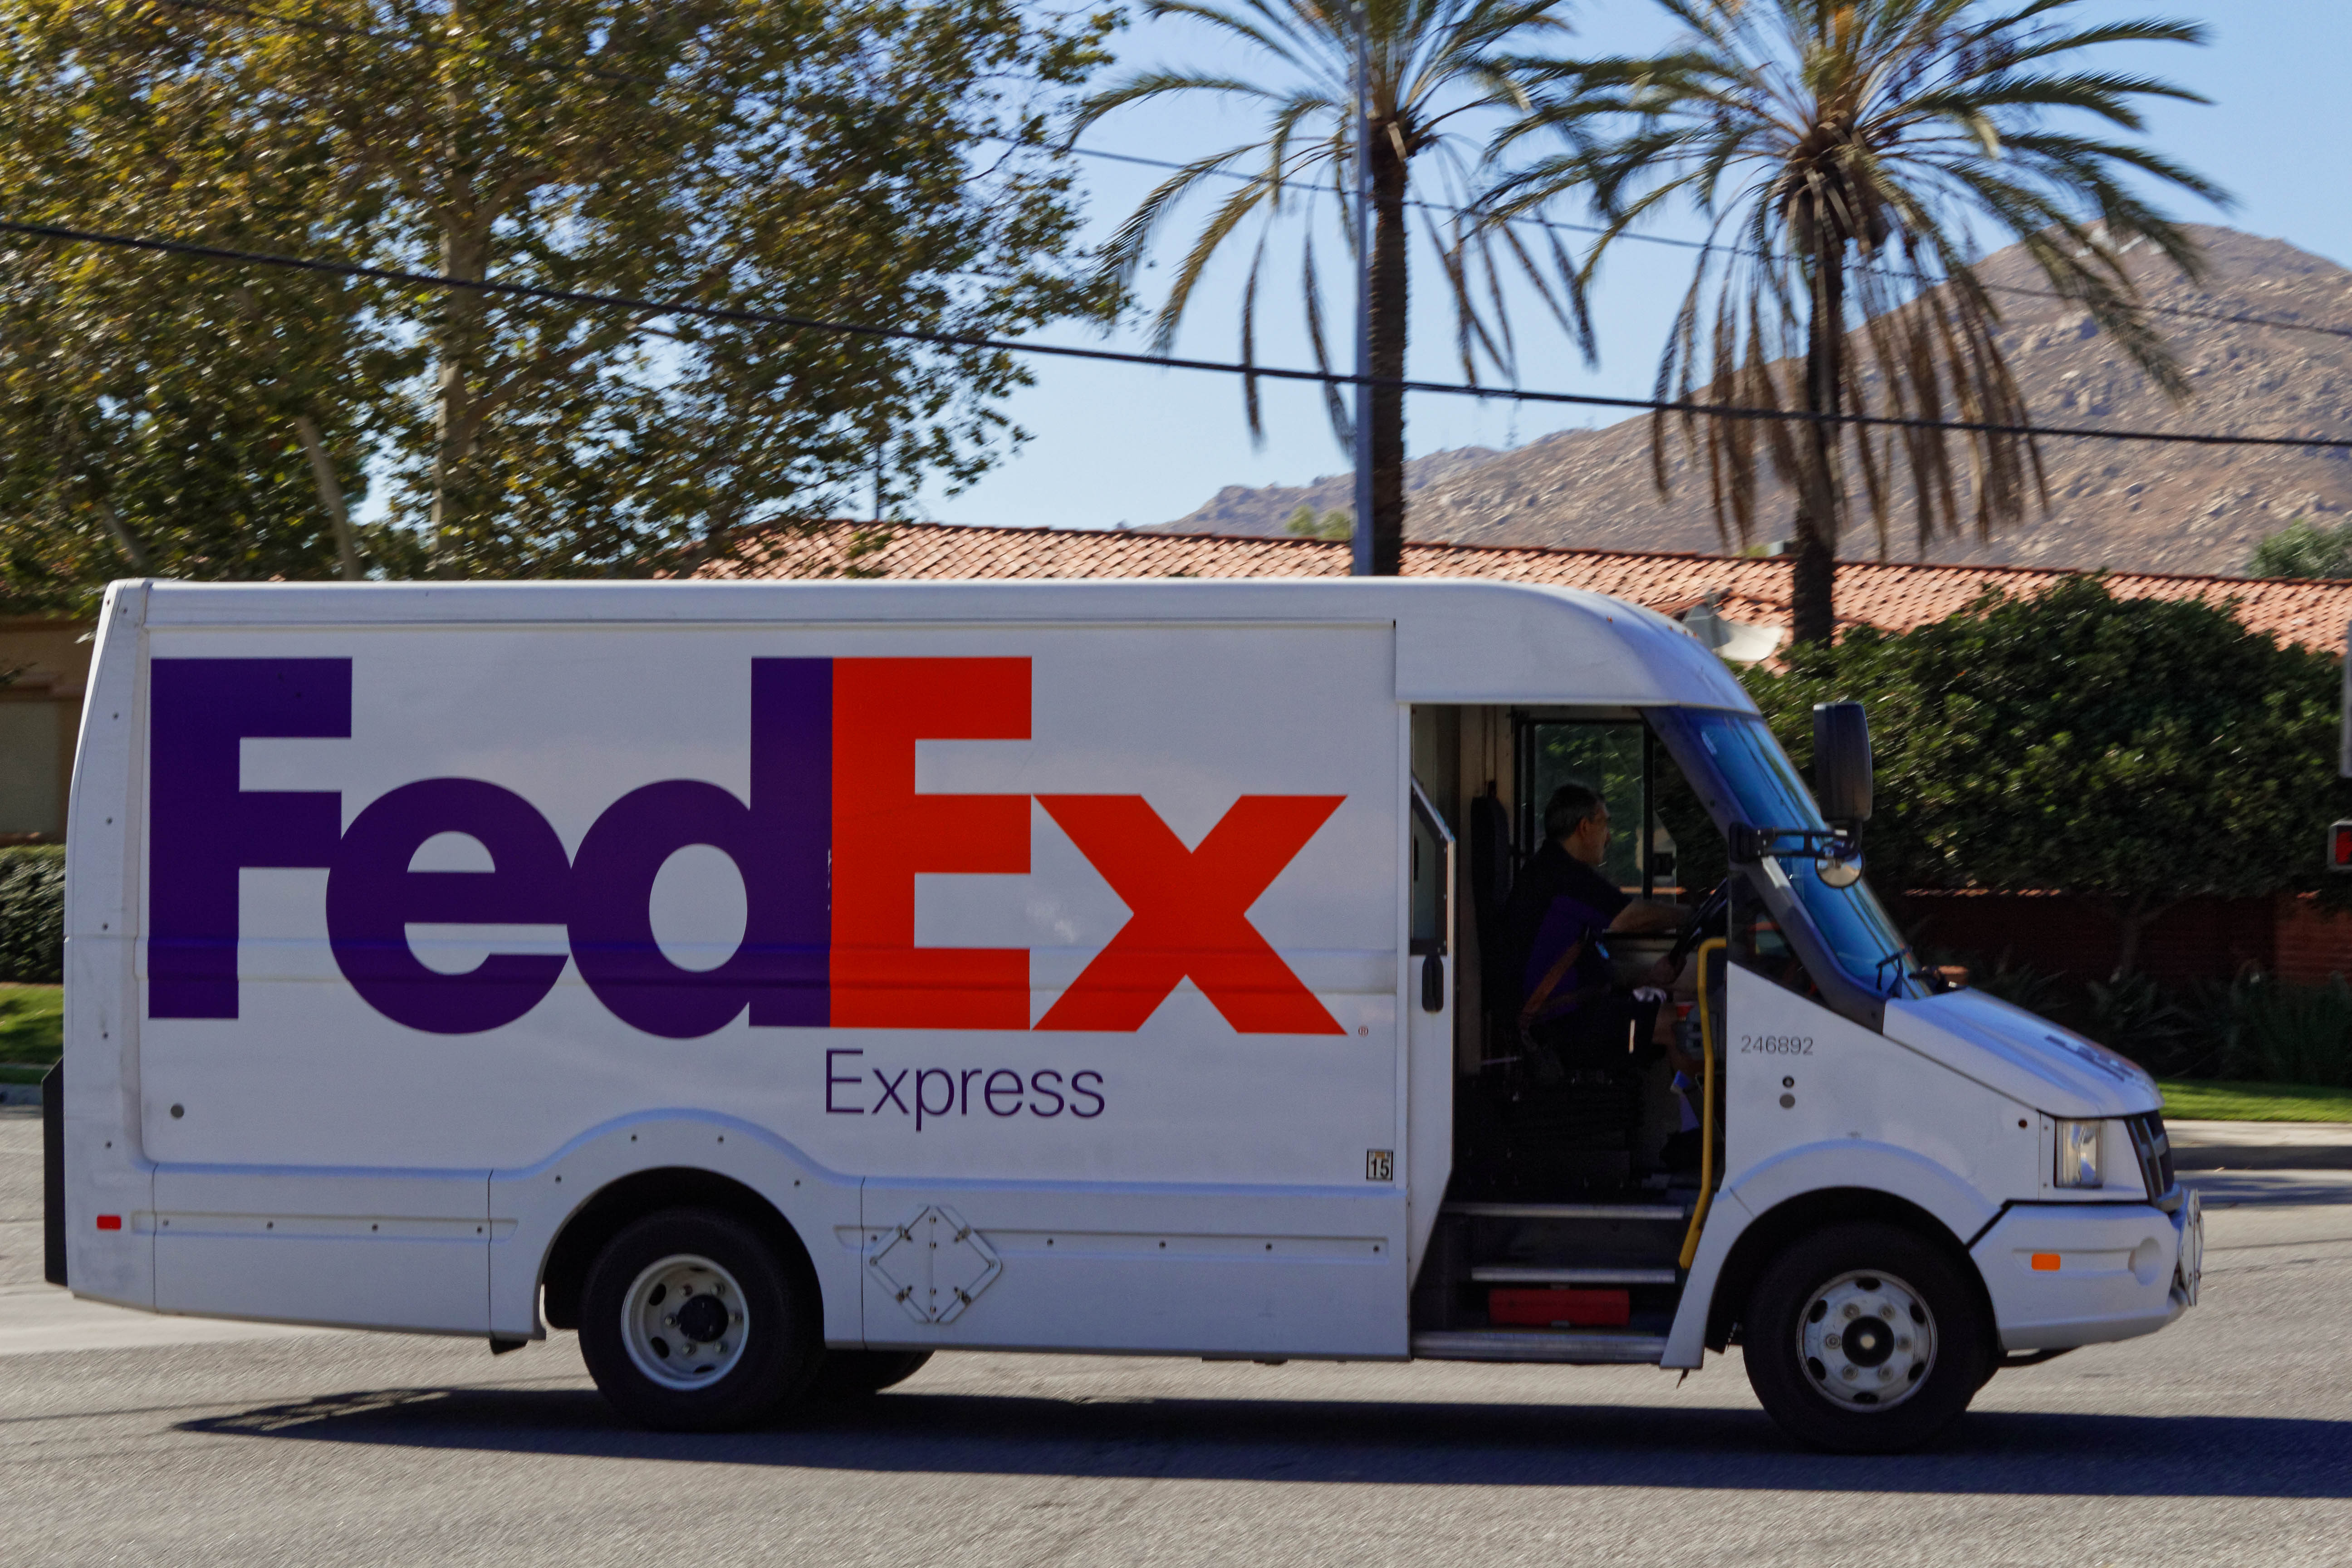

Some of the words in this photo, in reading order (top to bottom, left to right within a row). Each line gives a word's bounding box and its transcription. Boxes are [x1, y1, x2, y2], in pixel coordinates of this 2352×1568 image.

[148, 657, 1348, 1039] FedEx
[1741, 1034, 1813, 1055] 246892
[826, 1048, 1105, 1132] Express
[1370, 1158, 1390, 1179] 15
